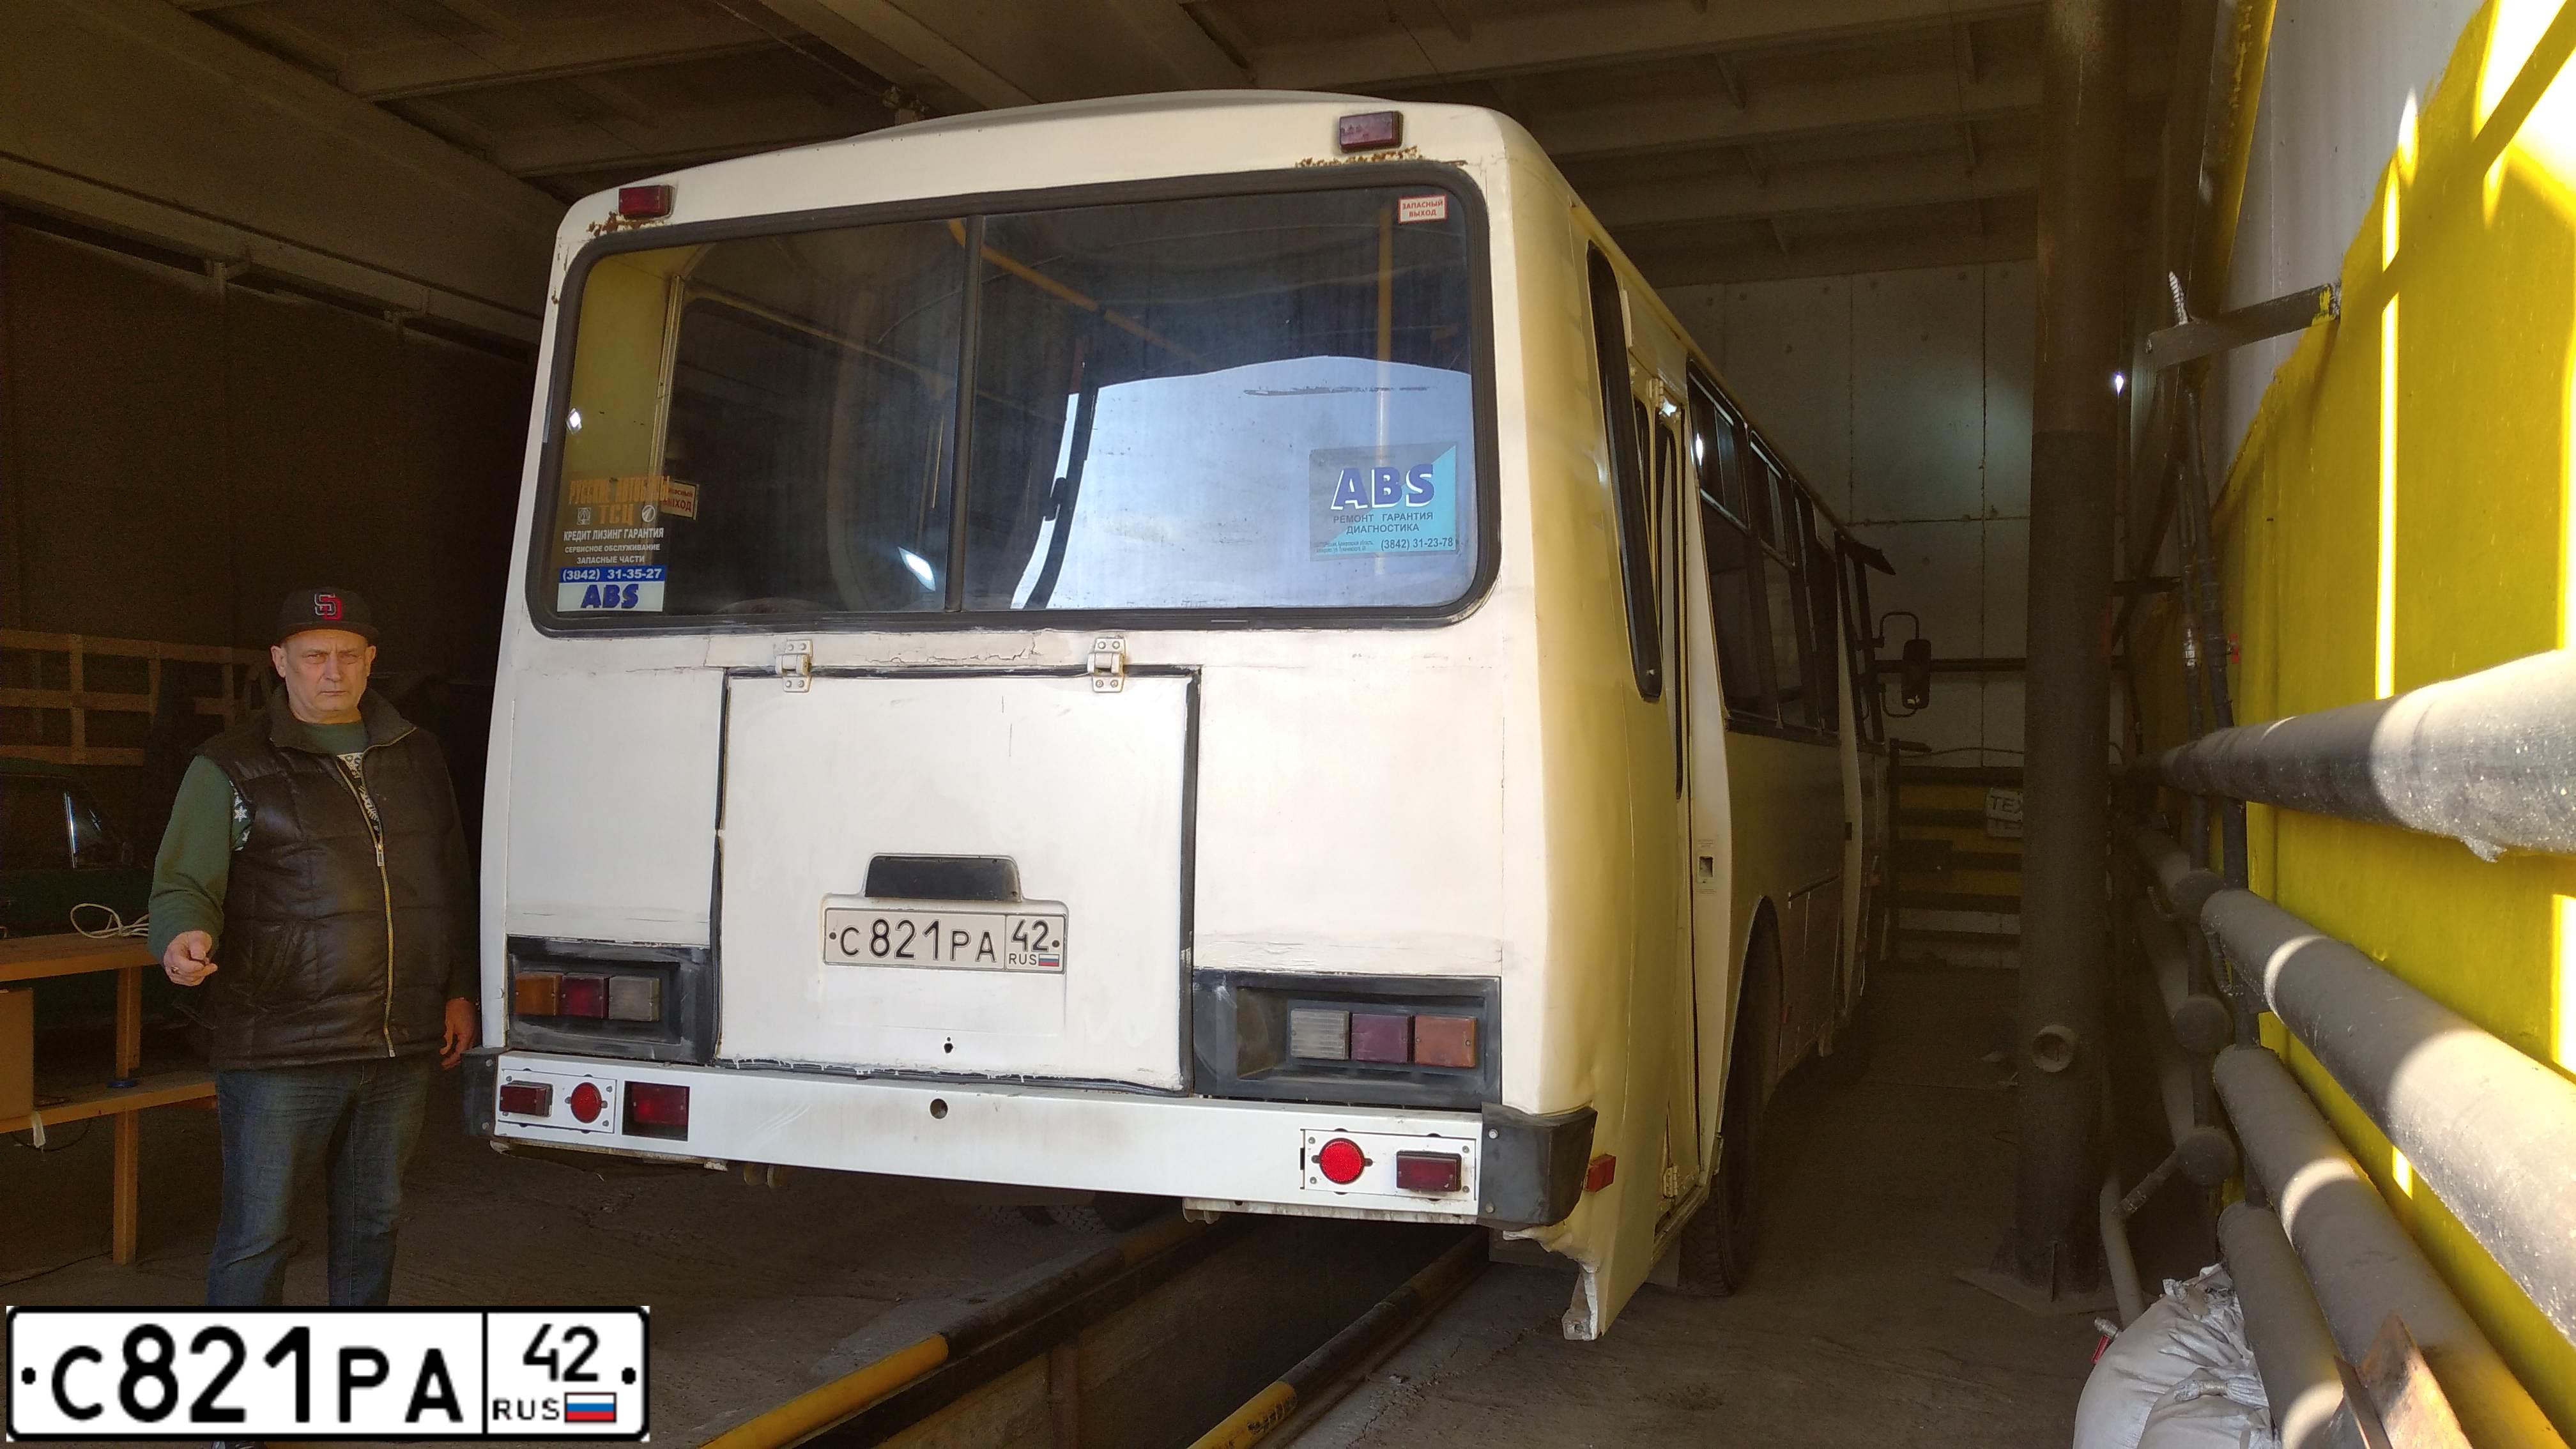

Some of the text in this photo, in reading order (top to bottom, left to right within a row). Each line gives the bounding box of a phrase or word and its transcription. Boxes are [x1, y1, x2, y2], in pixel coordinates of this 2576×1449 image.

[1402, 199, 1443, 210] ЗАПАСНЫЙ
[1409, 208, 1437, 218] ВЫХОД
[1330, 463, 1435, 510] ABS
[1333, 512, 1434, 524] РЕМОНТ ГАРАНТИЯ
[564, 527, 664, 542] КРЕДИТ ЛИЗИНГ ГАРАНТИЯ
[1346, 523, 1420, 535] ДИАГНОСТИКА
[565, 544, 661, 553] СЕРВИСНОЕ ОБСЛУЖИВАНИЕ
[1381, 539, 1410, 551] (3842)
[1413, 537, 1453, 548] 31-23-78
[619, 555, 645, 564] ЧАСТИ
[562, 568, 662, 581] (3842) 31-35-27
[580, 583, 640, 610] ABS
[1011, 918, 1050, 952] 42
[1009, 953, 1038, 966] RUS
